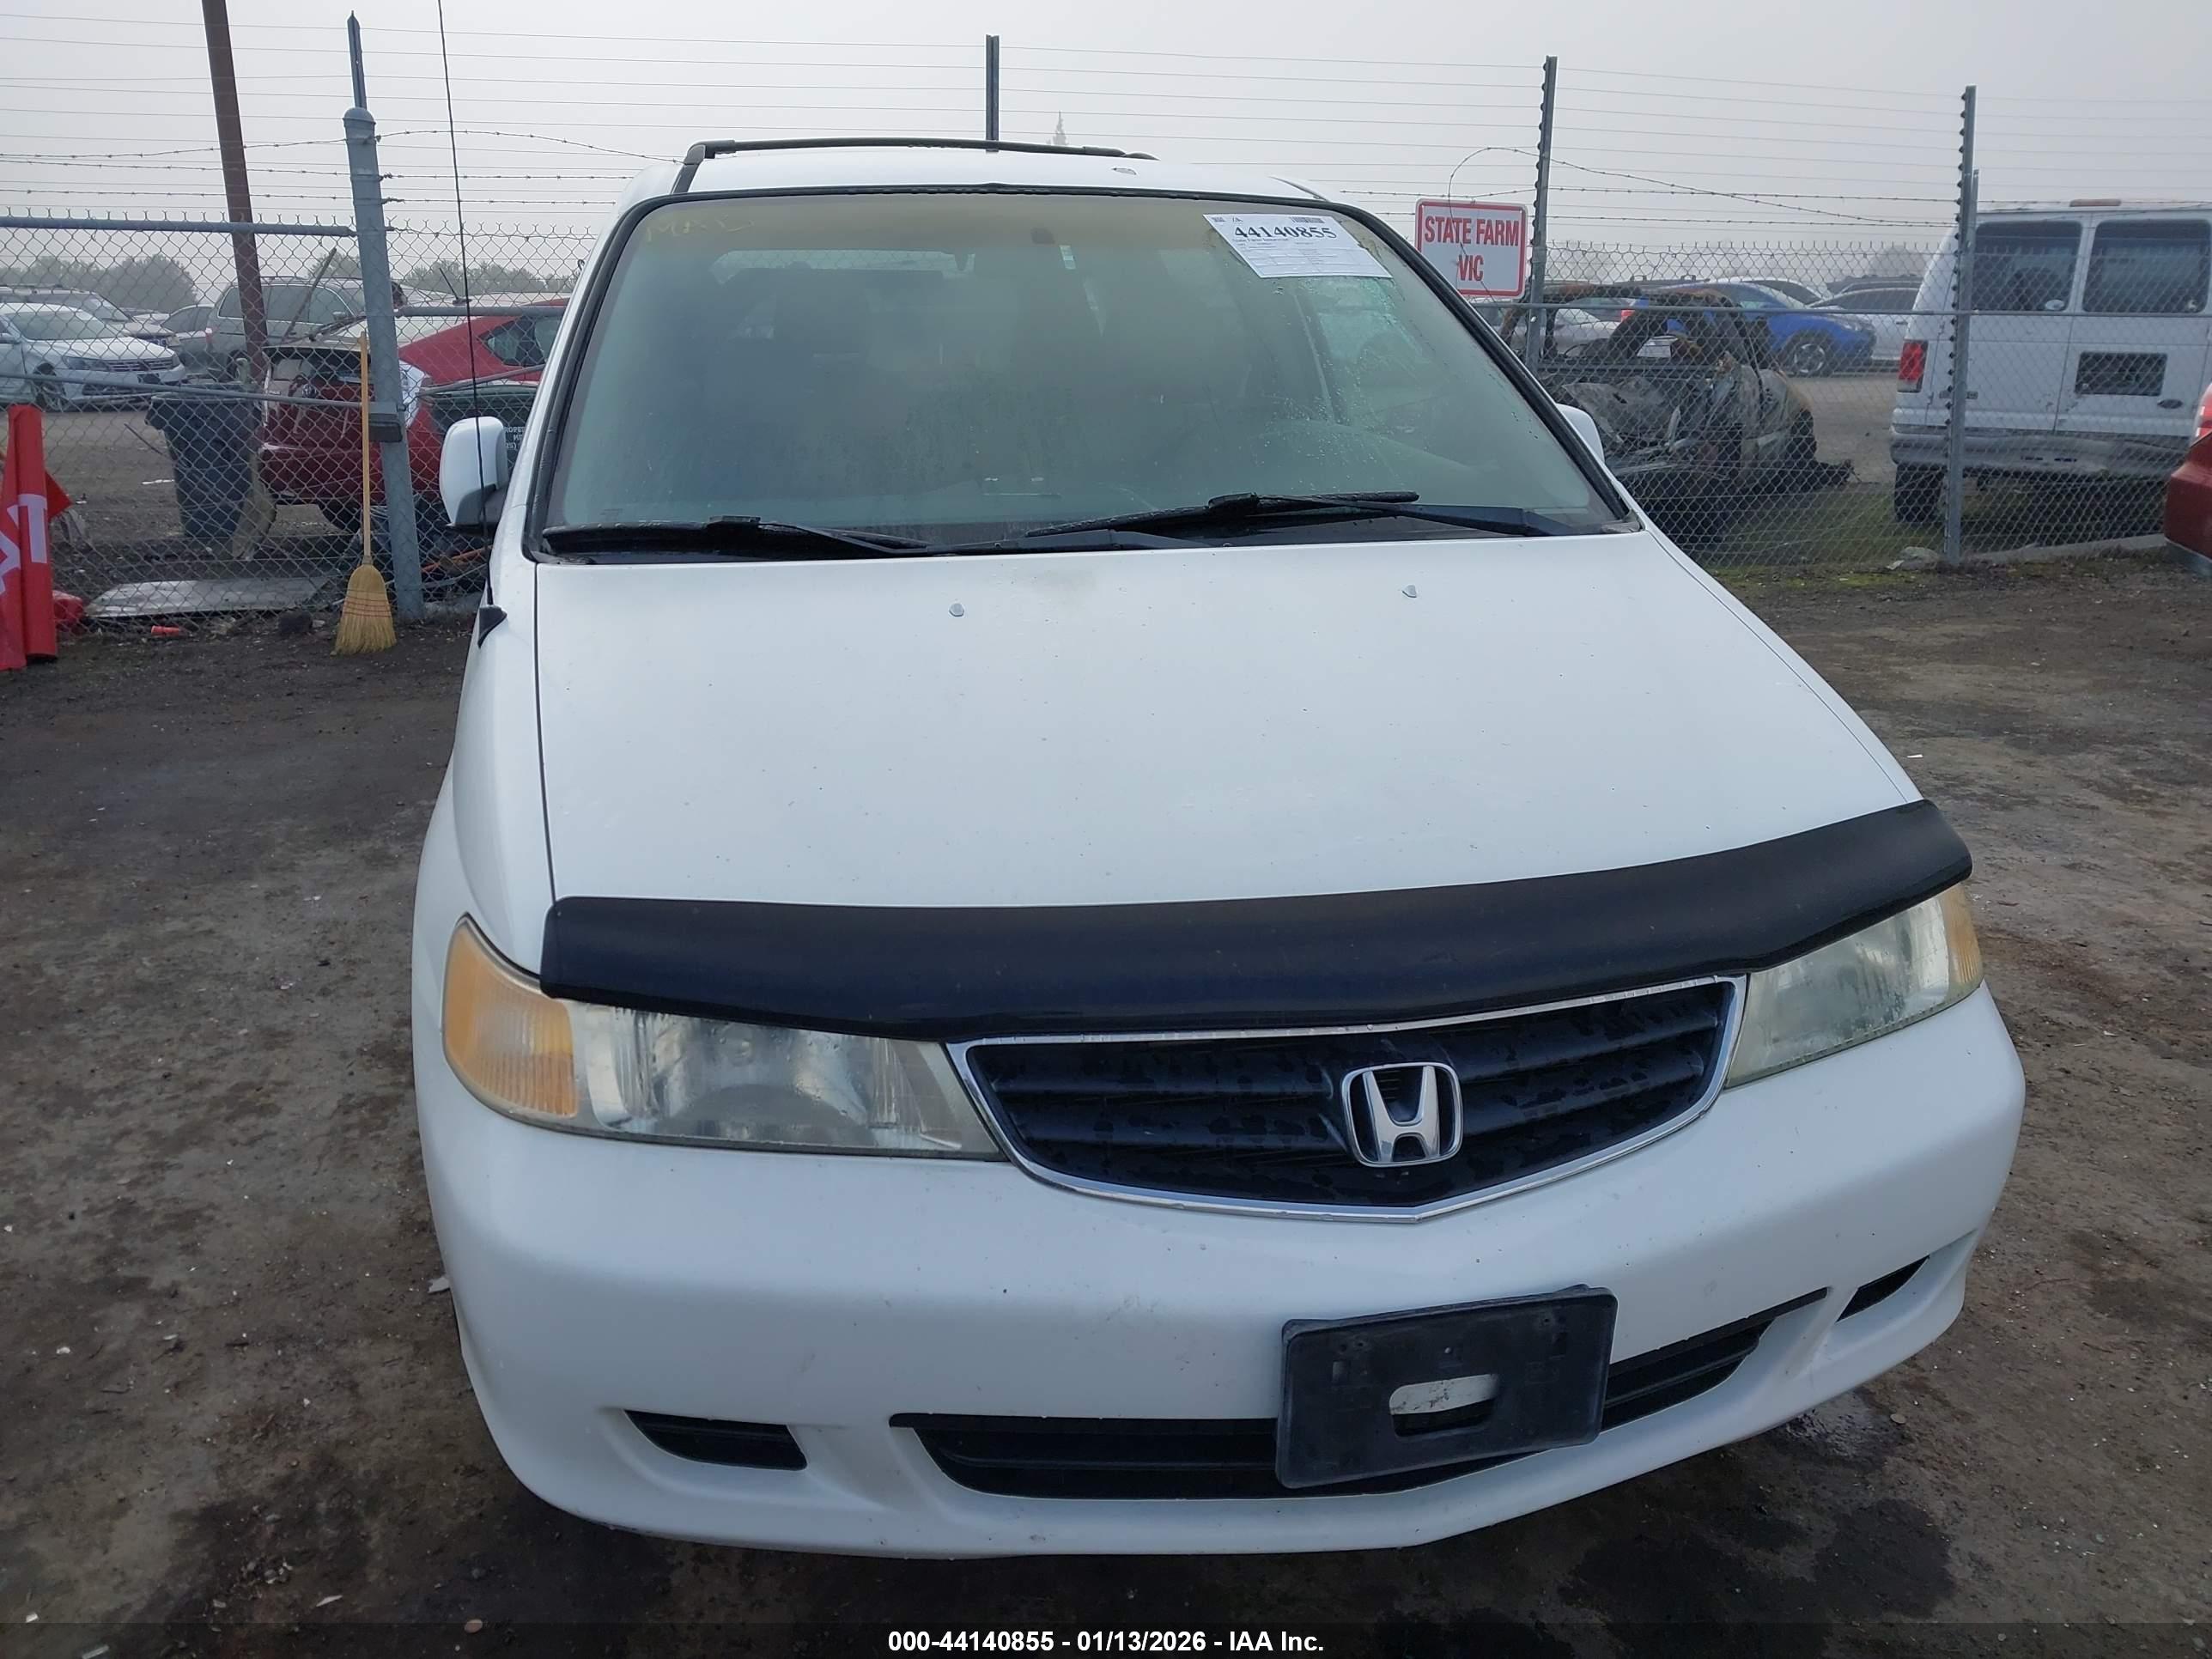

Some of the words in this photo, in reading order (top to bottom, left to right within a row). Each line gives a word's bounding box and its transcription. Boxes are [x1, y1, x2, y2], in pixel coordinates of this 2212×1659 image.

[1234, 226, 1337, 239] 44140855
[1425, 216, 1472, 244] STATE
[1476, 219, 1519, 246] FARM
[1458, 255, 1484, 281] VIC
